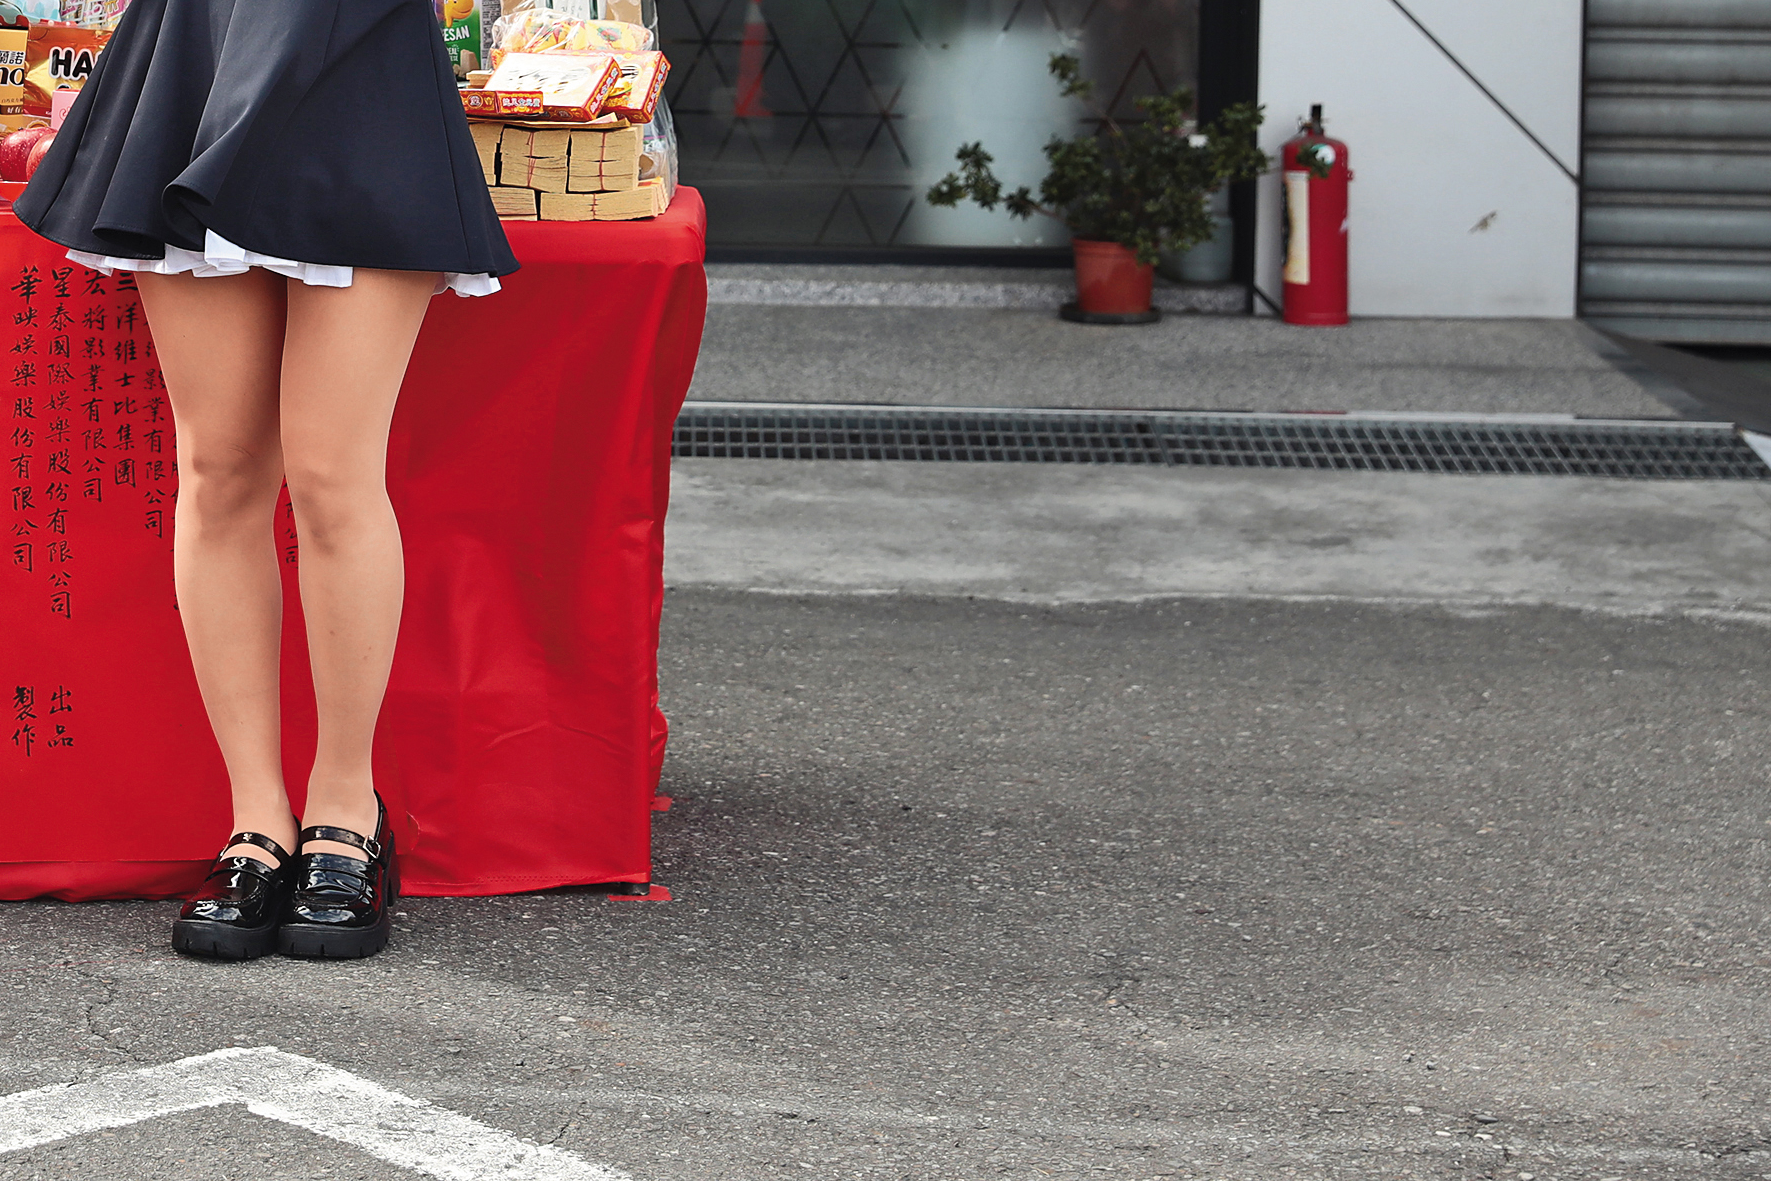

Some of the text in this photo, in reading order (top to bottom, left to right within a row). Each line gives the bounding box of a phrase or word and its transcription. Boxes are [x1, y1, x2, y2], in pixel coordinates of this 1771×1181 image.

[50, 48, 95, 79] HA
[443, 25, 470, 42] ESAN
[10, 265, 42, 757] 華映娛樂股份有限公司 製作
[44, 267, 76, 748] 星泰國際娛樂股份有限公司 出品
